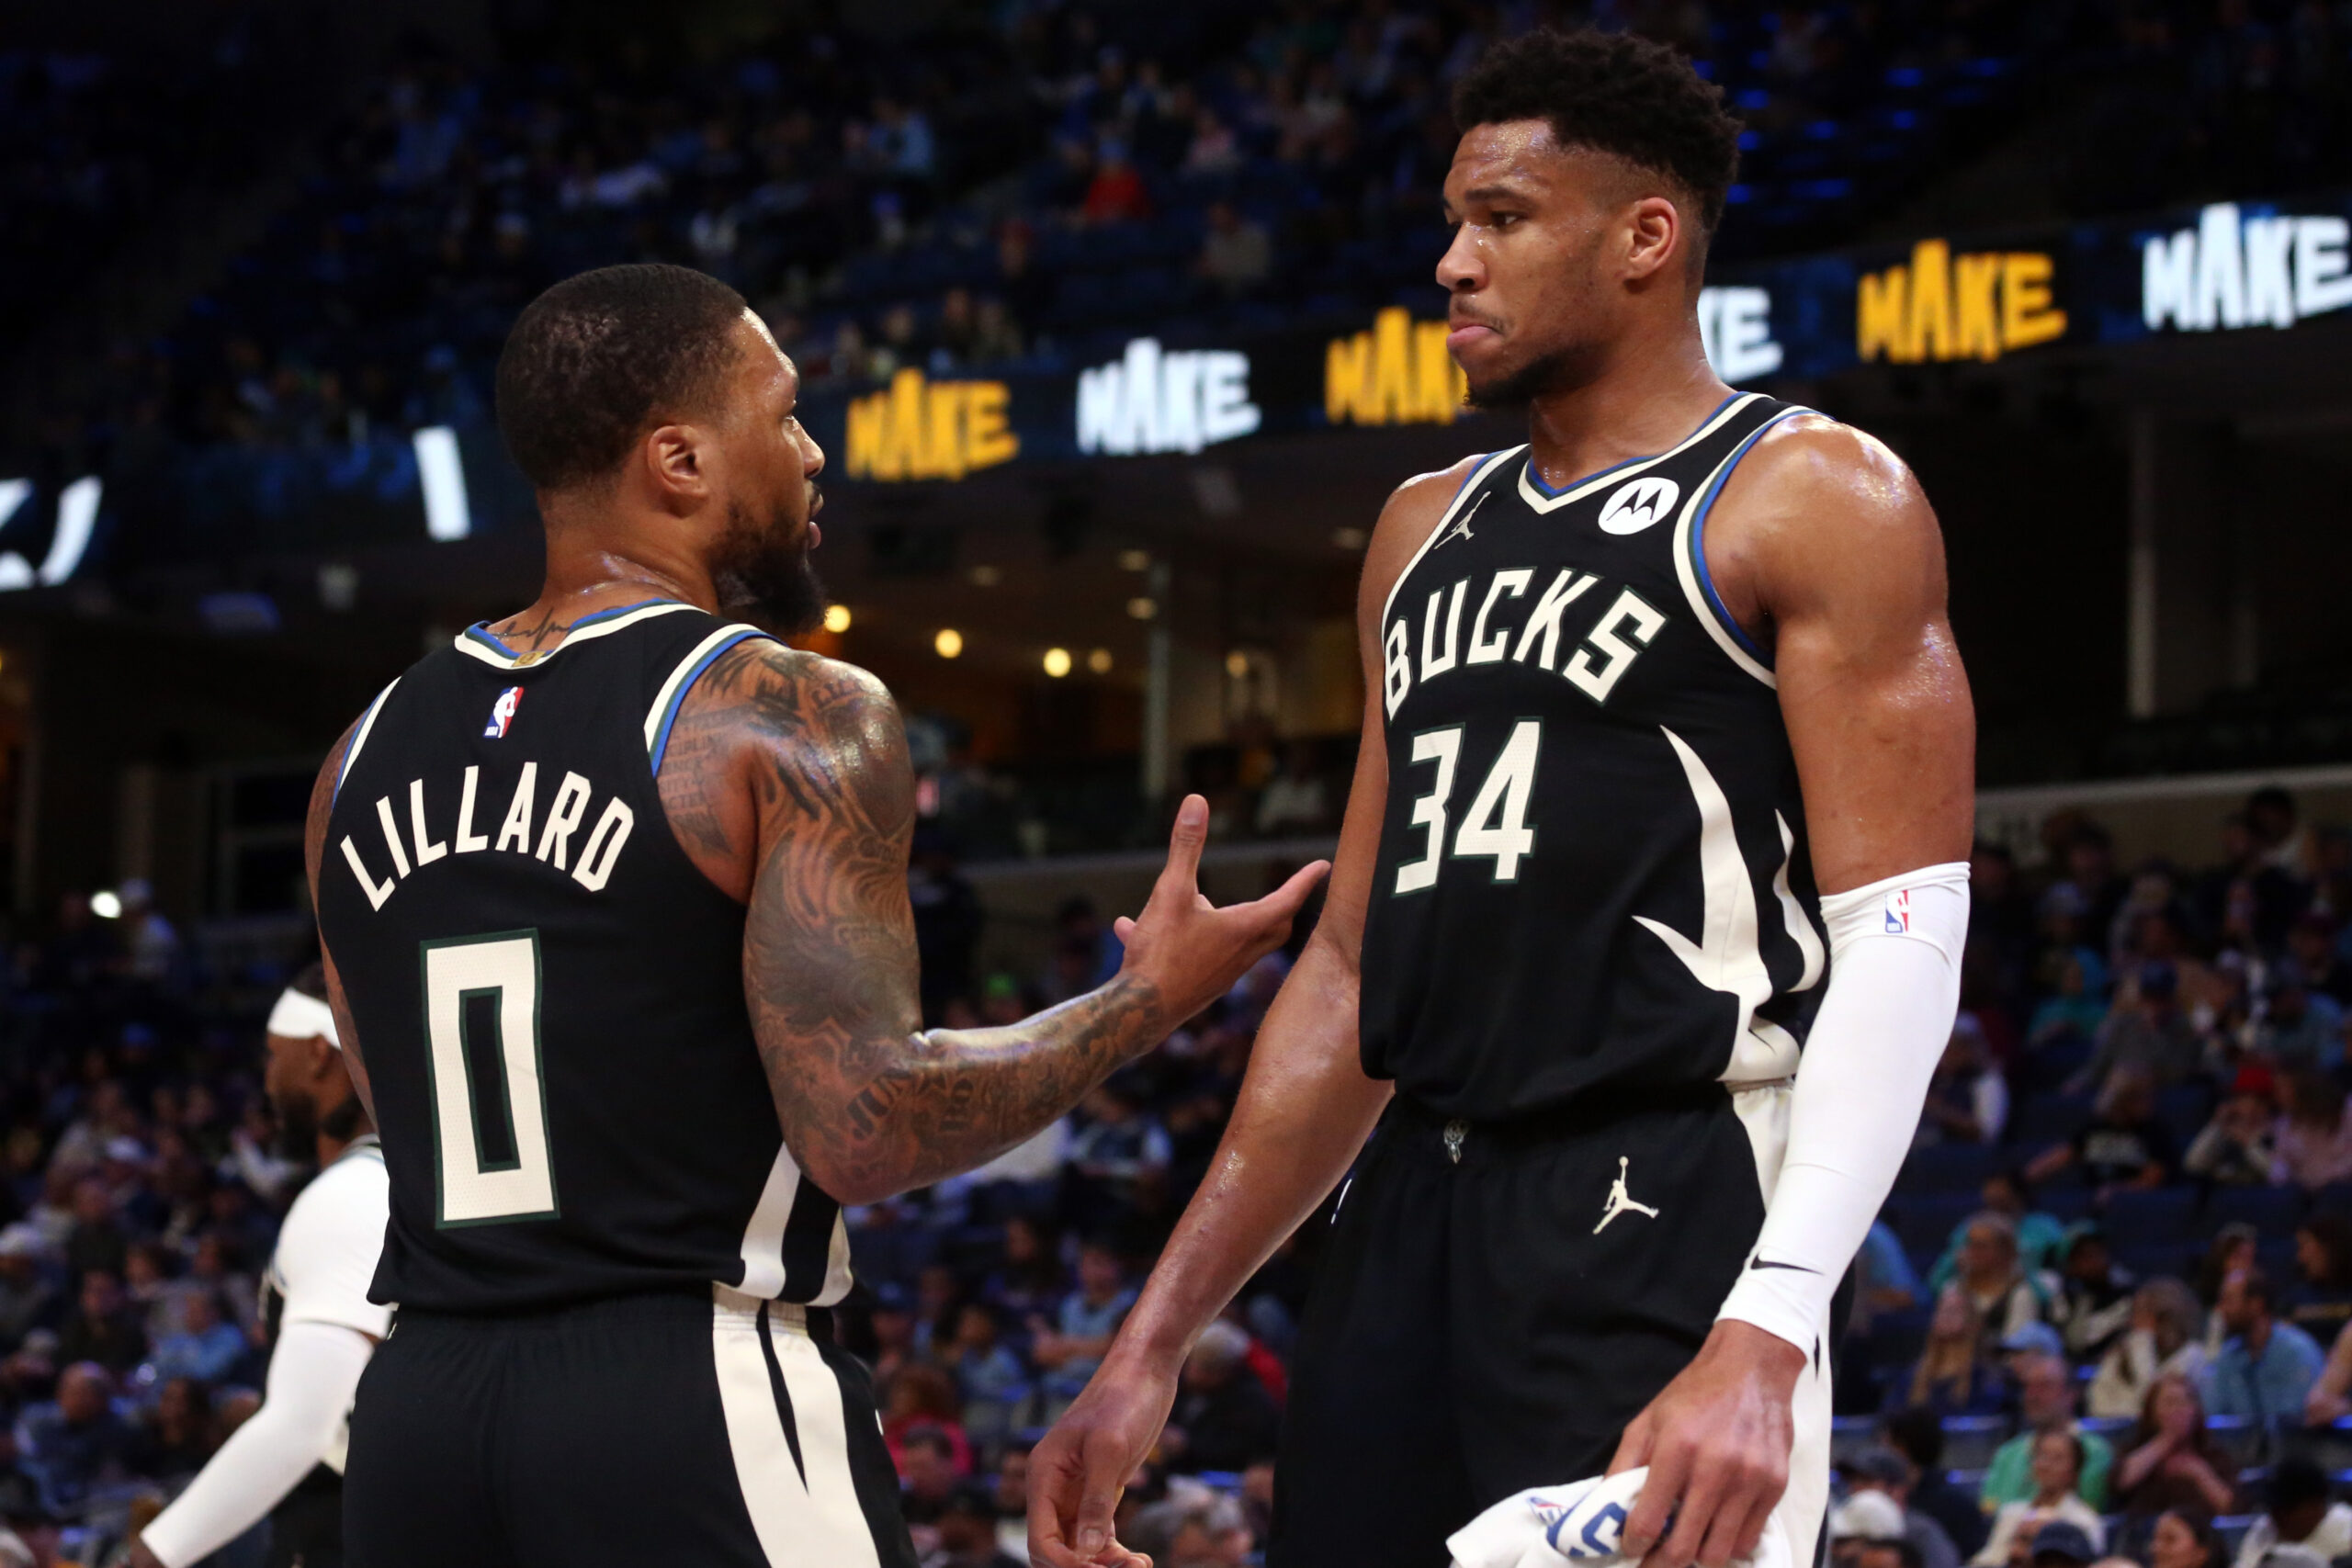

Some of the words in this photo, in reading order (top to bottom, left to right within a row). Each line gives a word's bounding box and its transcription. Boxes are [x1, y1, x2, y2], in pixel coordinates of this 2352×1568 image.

[845, 368, 1019, 481] MAKE
[1077, 336, 1261, 456] MAKE
[1325, 306, 1468, 427] MAK
[1857, 239, 2068, 364] MAKE
[2143, 201, 2352, 333] MAKE
[1384, 566, 1669, 724] BUCKS
[340, 761, 634, 912] LILLARD
[1392, 716, 1544, 897] 34
[420, 928, 560, 1230] 0
